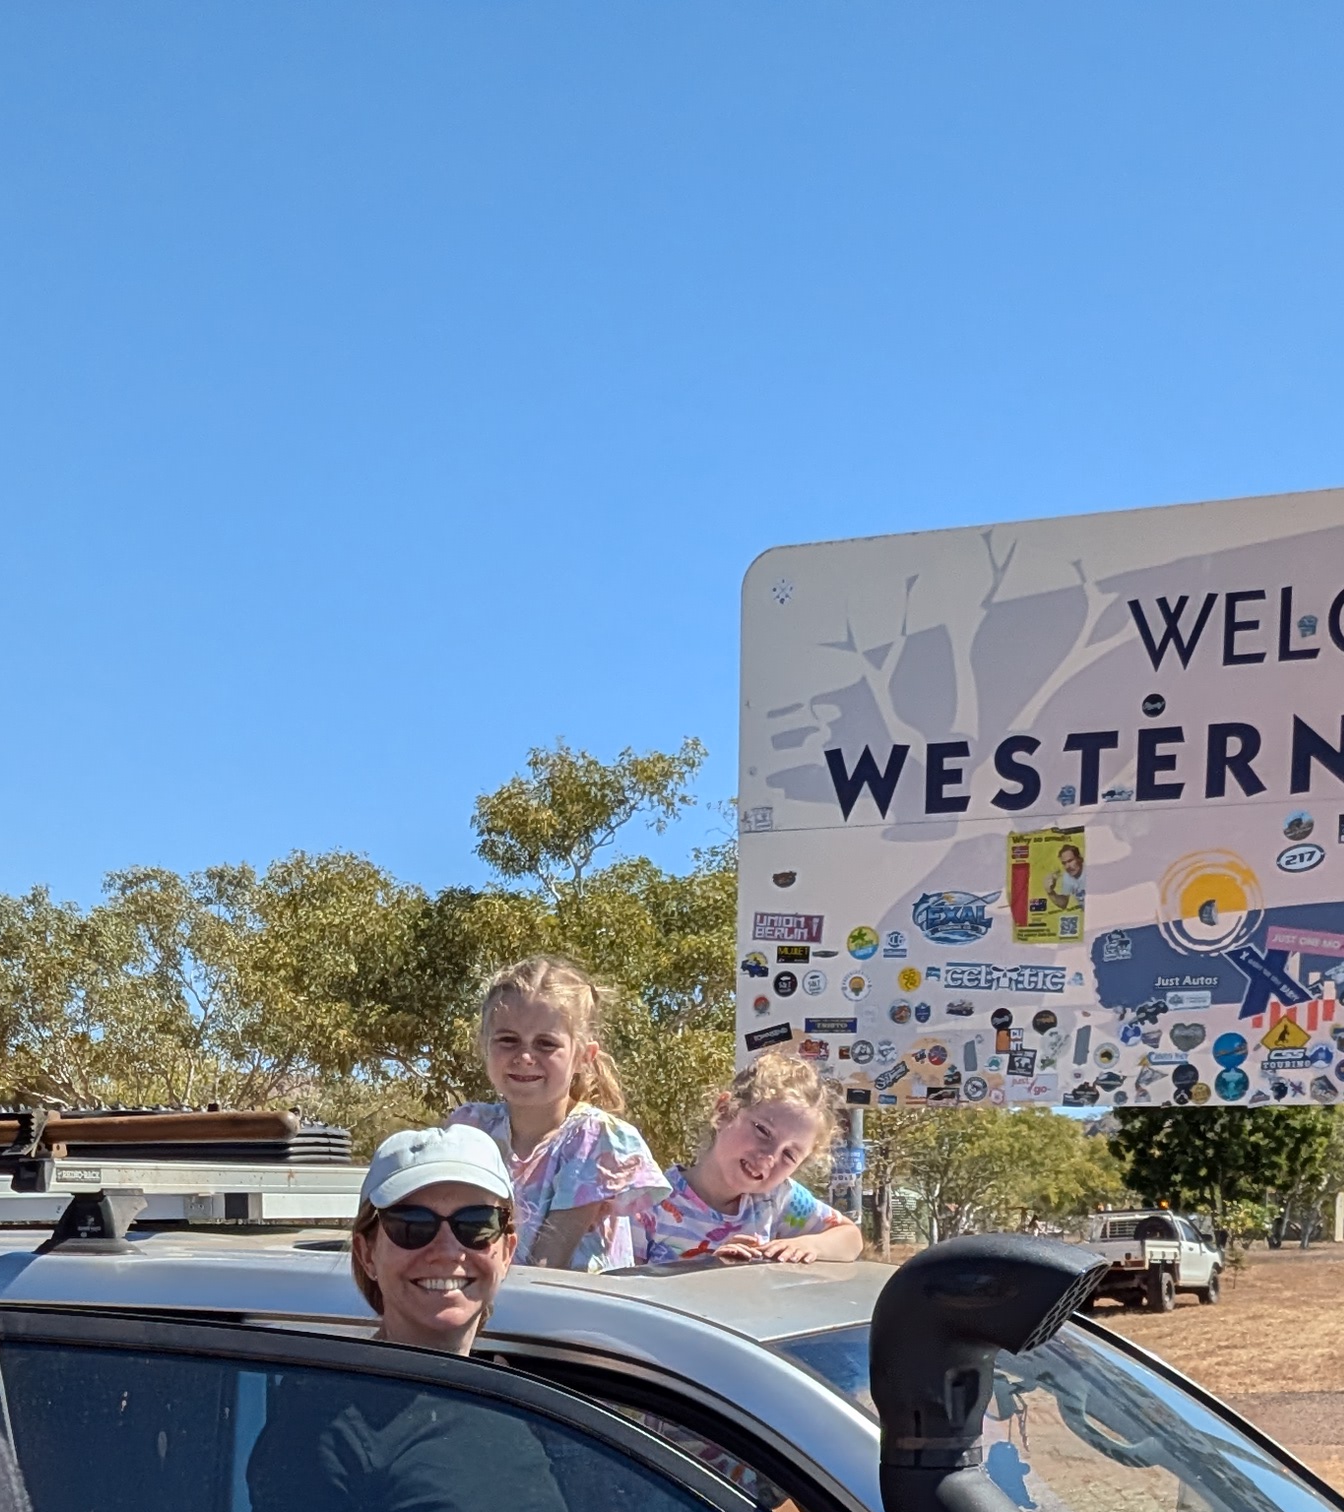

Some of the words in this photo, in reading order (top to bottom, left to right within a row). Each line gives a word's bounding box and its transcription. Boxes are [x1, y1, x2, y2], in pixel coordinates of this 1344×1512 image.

[1284, 850, 1316, 866] 217
[757, 914, 804, 927] UNION
[756, 927, 808, 940] BERLIN
[1272, 935, 1297, 943] JUST
[1155, 976, 1180, 986] Just
[1183, 975, 1218, 986] Autos
